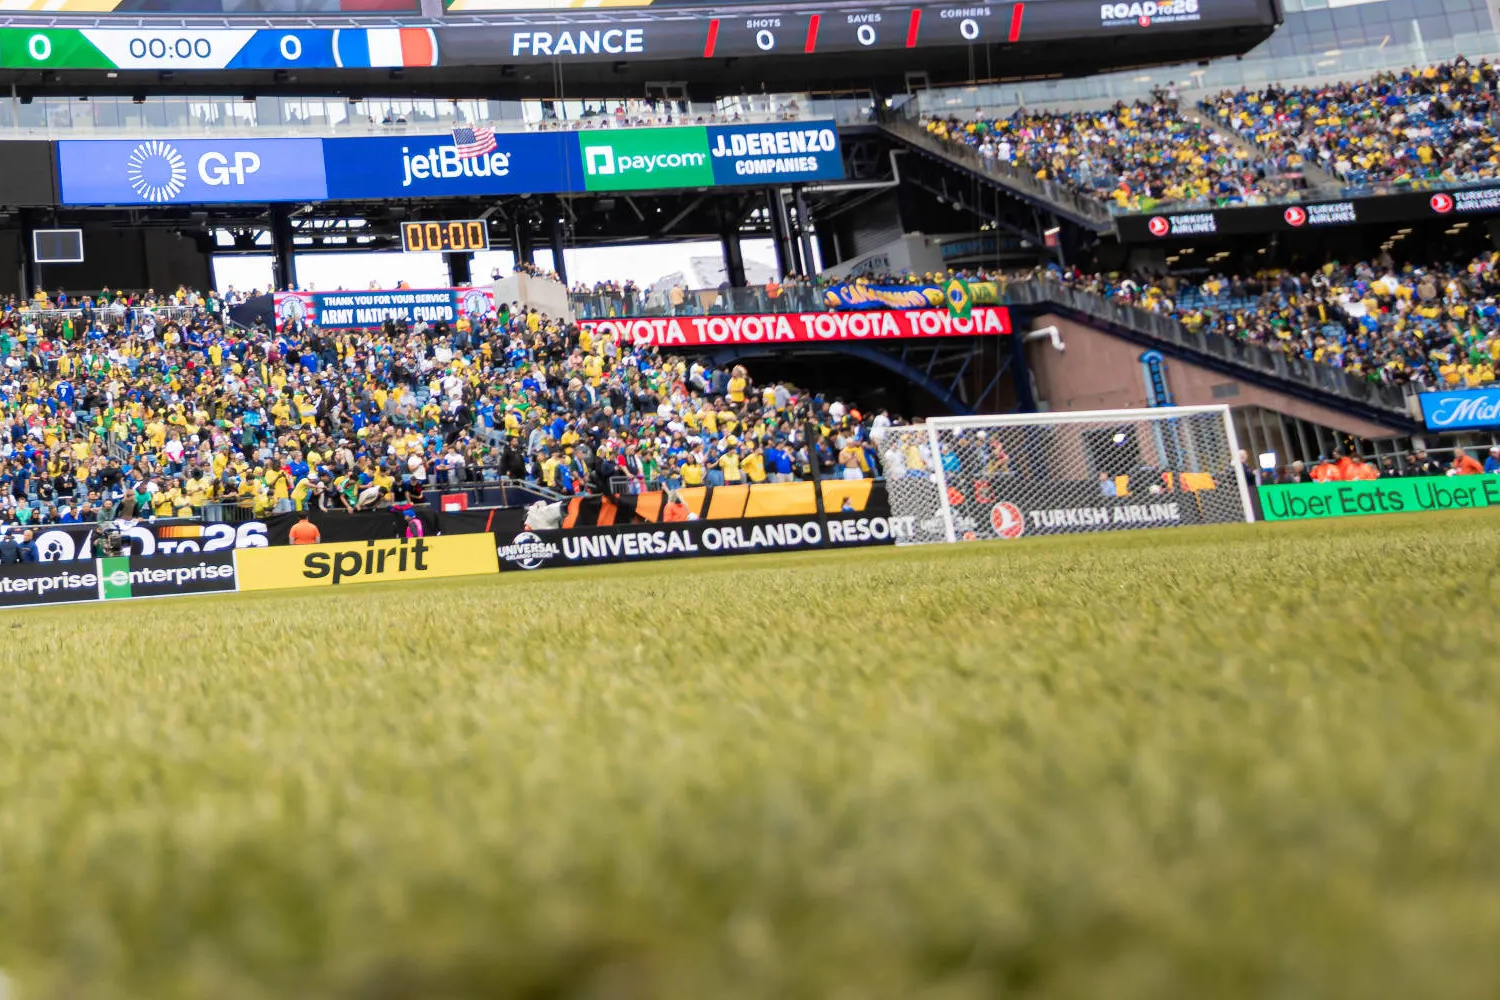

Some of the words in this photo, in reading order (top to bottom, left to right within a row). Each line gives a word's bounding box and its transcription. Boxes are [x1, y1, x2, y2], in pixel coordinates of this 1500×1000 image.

[847, 12, 881, 25] SAVES
[940, 7, 991, 20] CORNERS
[1100, 1, 1157, 19] ROAD
[746, 17, 781, 30] SHOTS
[959, 18, 980, 41] 0
[279, 34, 302, 60] 0
[512, 29, 645, 57] FRANCE
[755, 29, 775, 52] 0
[856, 24, 876, 47] 0
[28, 34, 52, 61] 0
[128, 37, 212, 60] 00:00
[198, 151, 261, 186] GP
[402, 146, 510, 187] jetBlue
[618, 152, 703, 174] paycom
[735, 157, 819, 176] COMPANIES
[1307, 202, 1354, 215] TURKISH
[1308, 211, 1356, 224] AIRLINES
[406, 221, 484, 252] 00:00
[323, 297, 354, 306] THANK
[355, 296, 373, 306] YOU
[374, 295, 391, 305] FOR
[391, 294, 415, 304] YOUR
[415, 293, 450, 303] SERVICE
[321, 308, 354, 325] ARMY
[691, 313, 792, 342] TOYOTA
[799, 310, 900, 340] TOYOTA
[905, 309, 1003, 335] TOYOTA
[1266, 490, 1332, 518] Uber
[1338, 486, 1405, 514] Eats
[1413, 481, 1477, 509] Uber
[1029, 507, 1110, 529] TURKISH
[563, 529, 698, 560] UNIVERSAL
[702, 518, 822, 551] ORLANDO
[826, 515, 916, 542] RESORT
[302, 538, 430, 584] spirit
[497, 542, 560, 558] UNIVERSAL
[108, 561, 234, 588] enterprise
